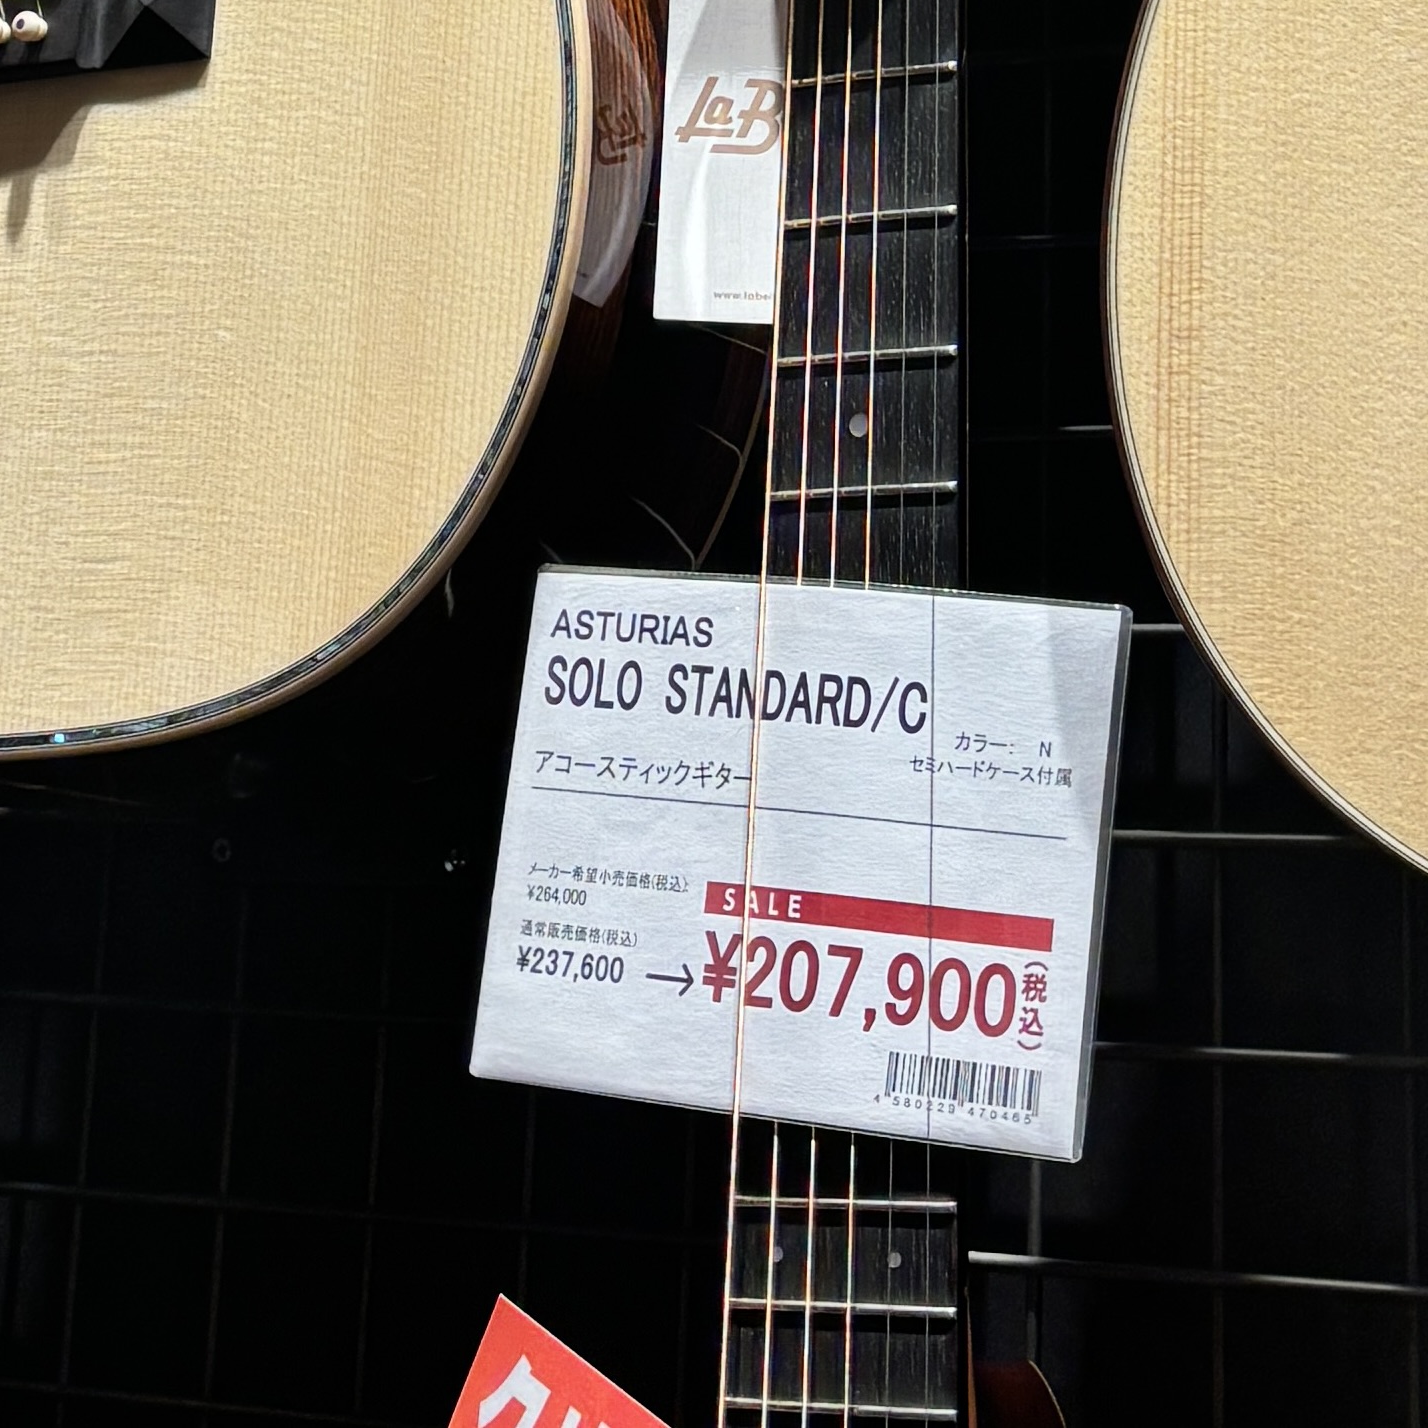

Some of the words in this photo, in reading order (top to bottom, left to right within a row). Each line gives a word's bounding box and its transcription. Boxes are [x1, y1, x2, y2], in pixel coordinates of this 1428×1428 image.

[550, 609, 714, 648] ASTURIAS
[545, 655, 643, 711] SOLO
[665, 663, 928, 734] STANDARD/C
[1039, 741, 1052, 758] N
[535, 750, 752, 790] アコースティックギター
[527, 885, 587, 907] ¥264,000
[722, 888, 802, 918] SALE
[520, 919, 638, 947] 通常販売価格(税込)
[516, 945, 624, 984] ¥237,600
[702, 930, 1017, 1038] ¥207,900
